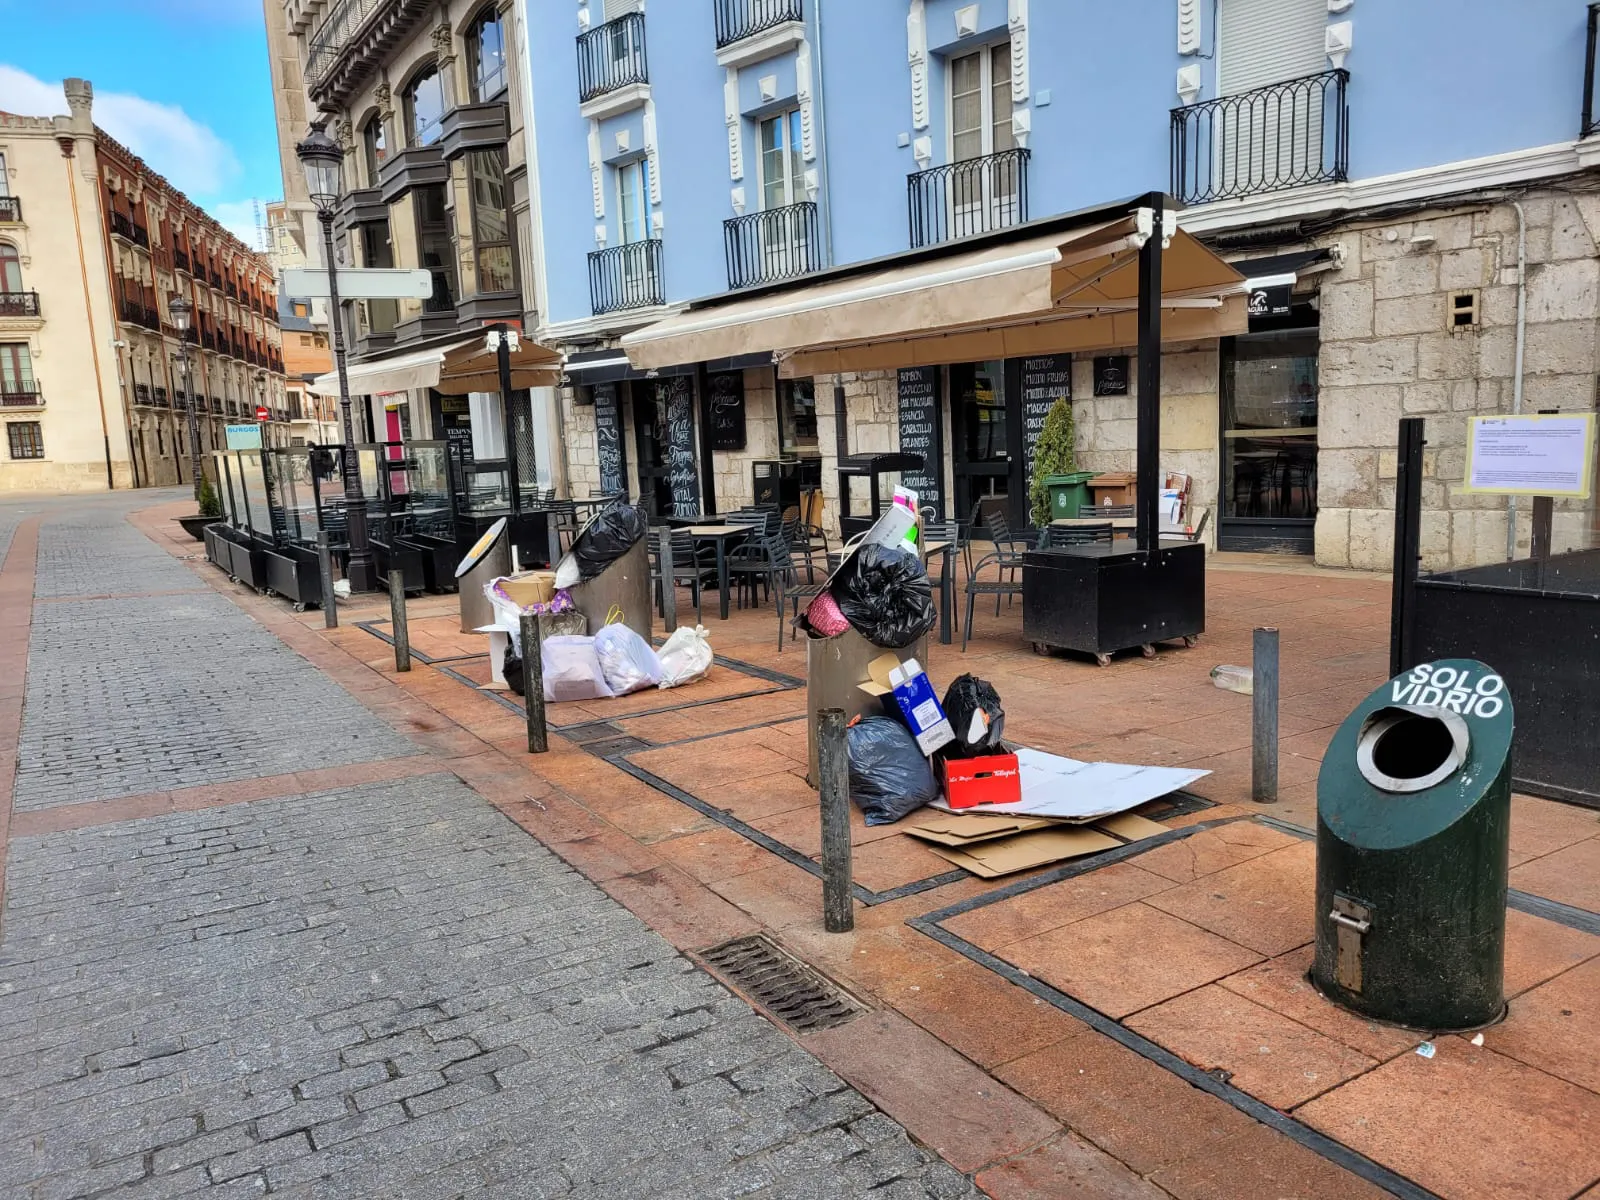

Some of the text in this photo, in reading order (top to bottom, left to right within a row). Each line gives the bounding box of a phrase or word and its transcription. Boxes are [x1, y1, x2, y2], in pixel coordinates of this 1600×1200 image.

[674, 488, 694, 502] VITAL
[673, 503, 697, 517] ZUMOS
[1408, 663, 1504, 697] SOLO
[1391, 680, 1504, 719] VIDRIO
